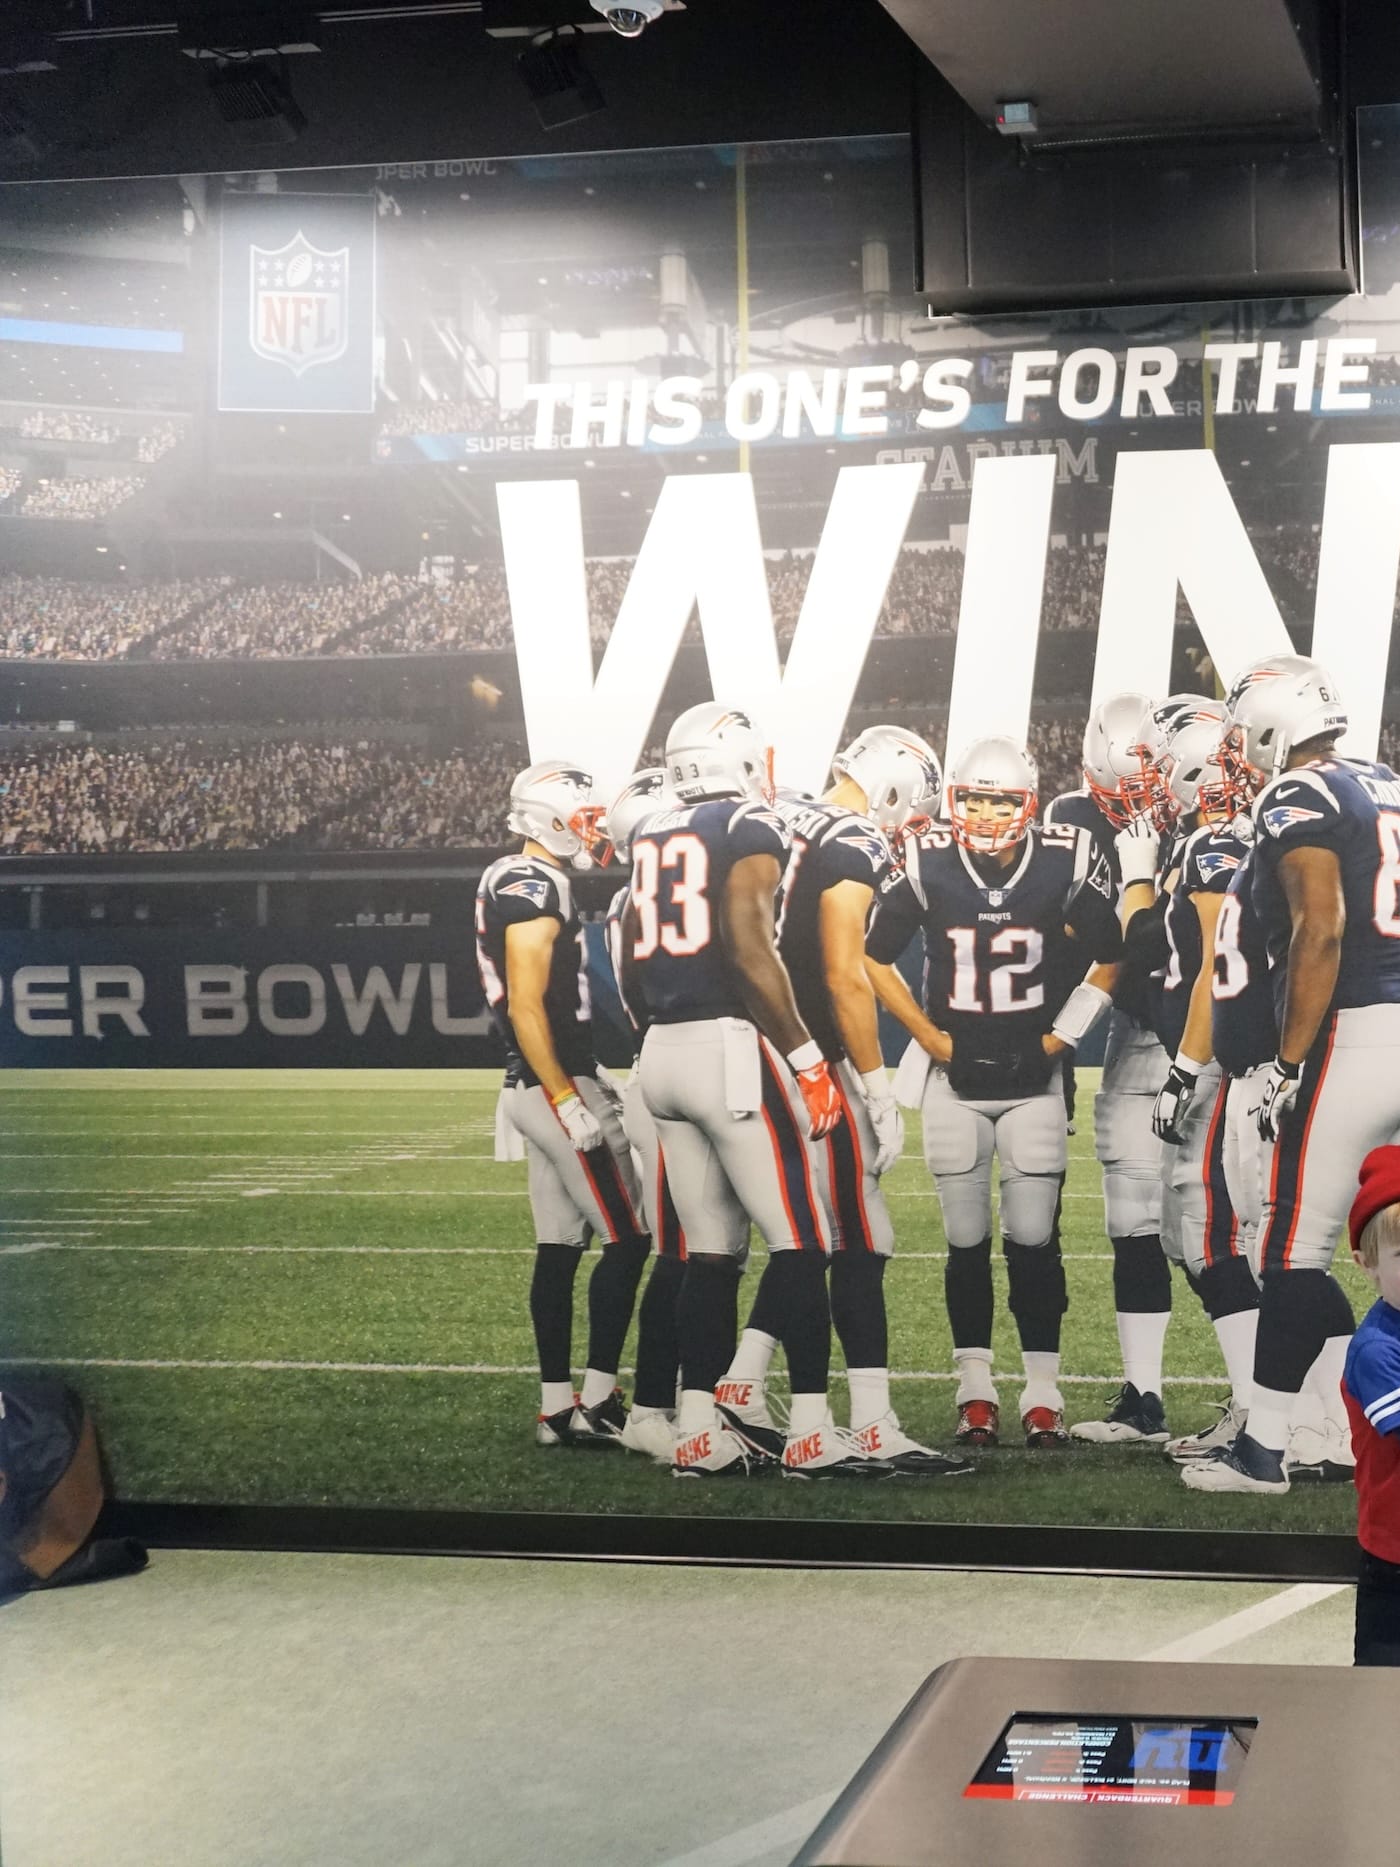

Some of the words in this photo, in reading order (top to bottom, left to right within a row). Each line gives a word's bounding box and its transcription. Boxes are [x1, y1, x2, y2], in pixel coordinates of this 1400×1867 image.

[262, 295, 337, 354] NFL
[523, 376, 704, 449] THIS
[724, 358, 975, 443] ONE'S
[1004, 346, 1179, 423] FOR
[1203, 337, 1377, 414] THE
[978, 911, 1012, 924] PATRIOTS
[945, 926, 1045, 1014] 12
[0, 964, 151, 1039] ER
[184, 962, 495, 1037] BOWL
[714, 1383, 753, 1406] NIKE
[675, 1431, 712, 1468] NIKE
[785, 1432, 824, 1468] NIKE
[1028, 1792, 1089, 1801] CHALLENGE
[1097, 1794, 1173, 1804] QUARTERBACK
